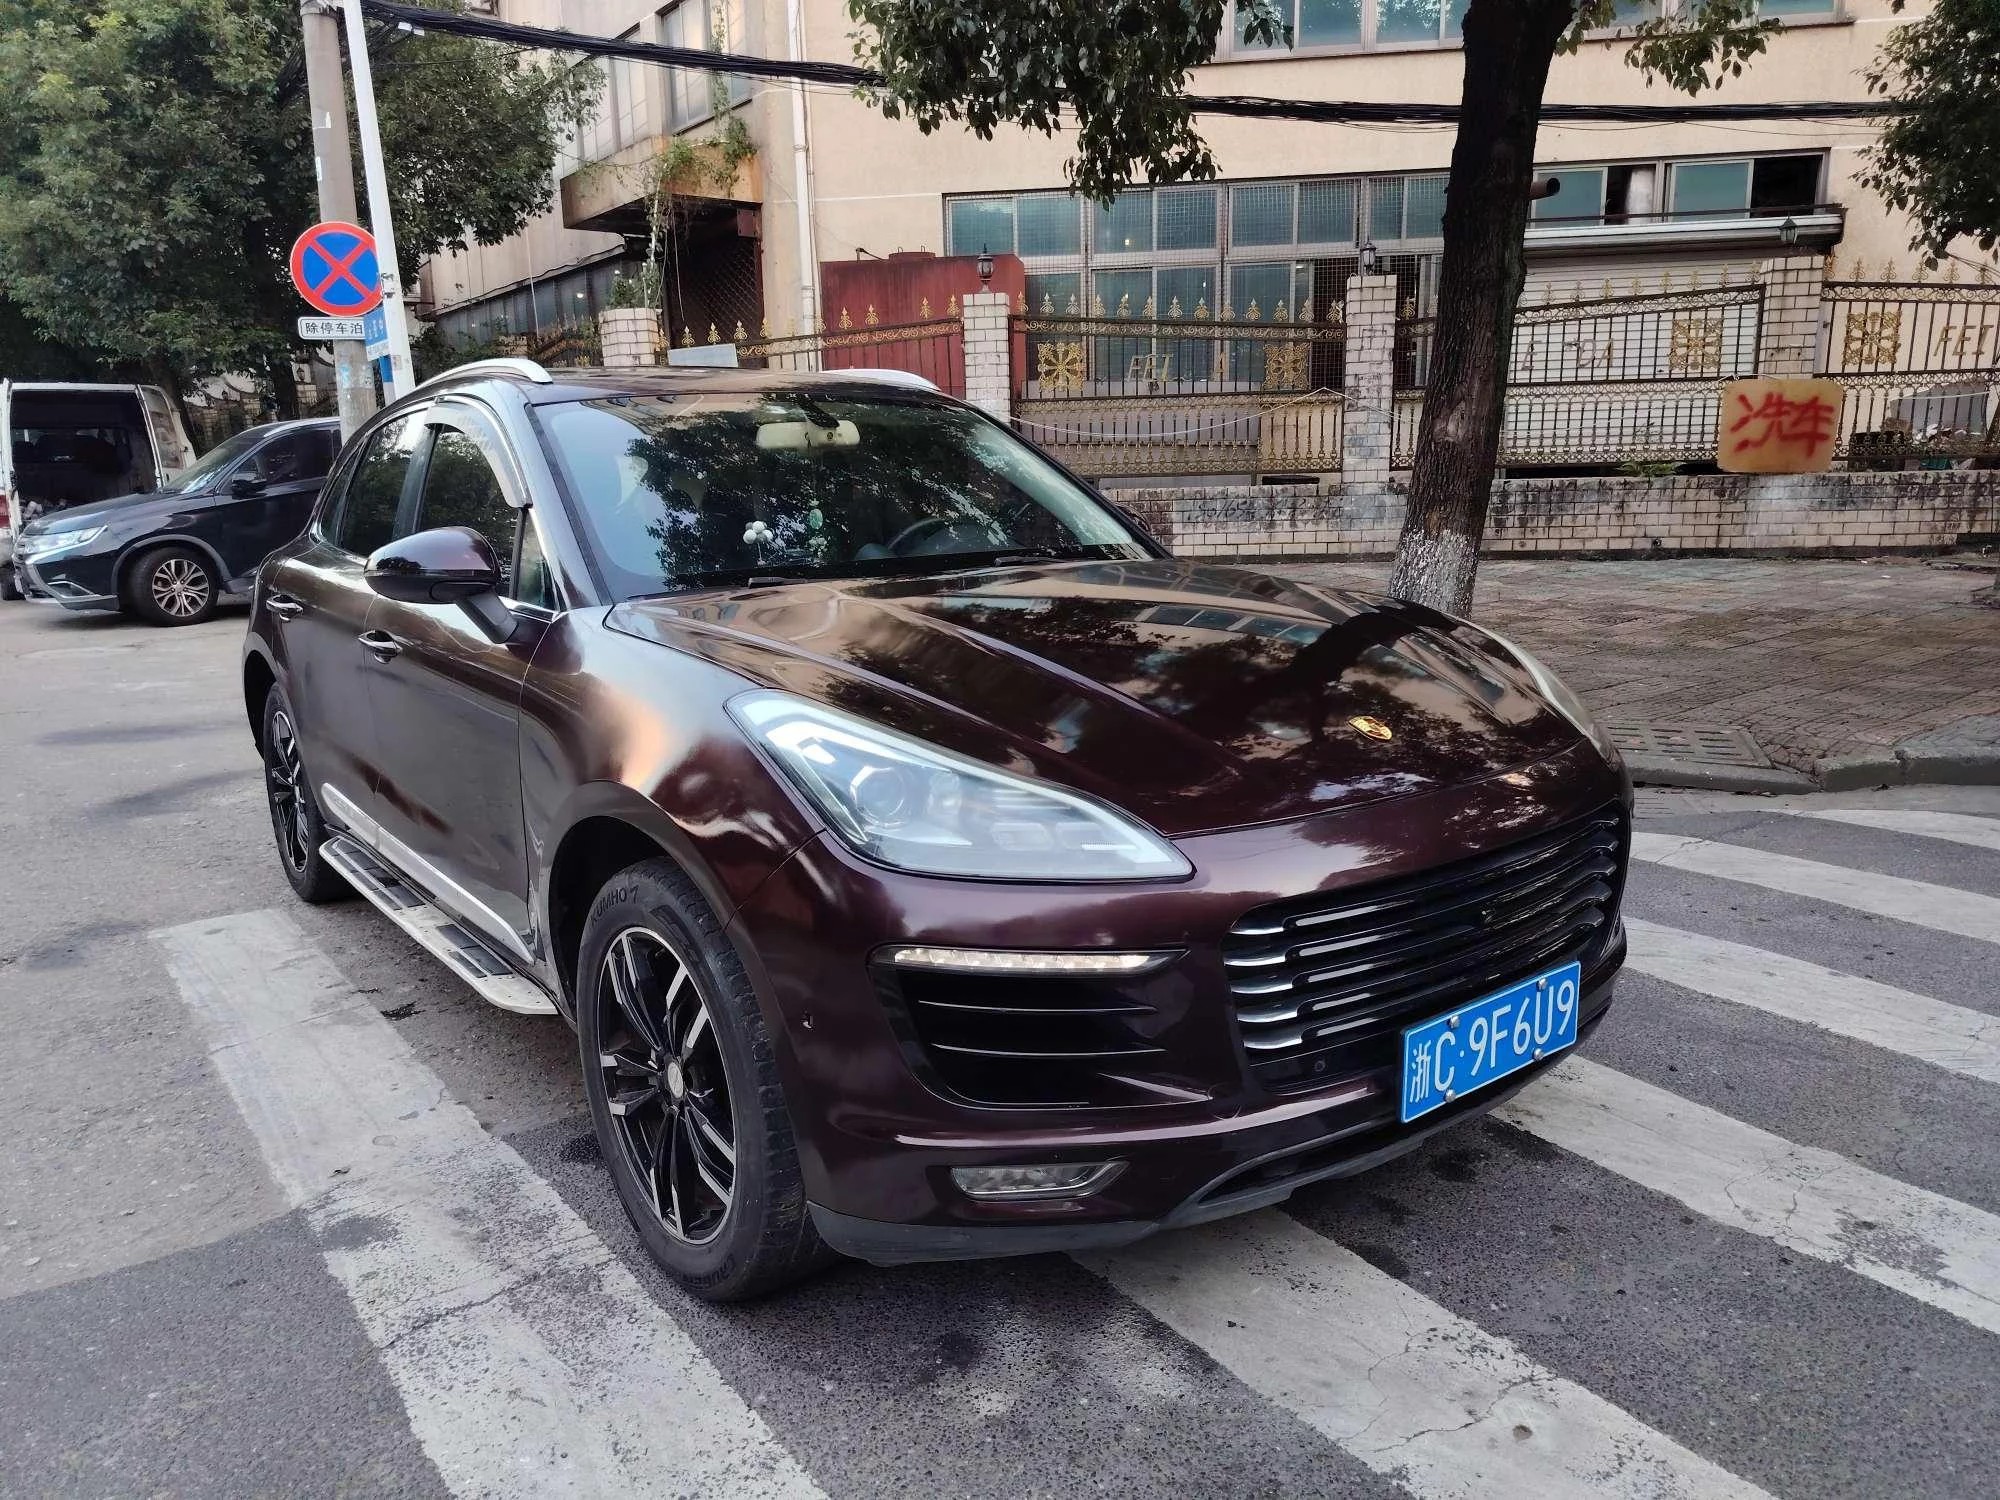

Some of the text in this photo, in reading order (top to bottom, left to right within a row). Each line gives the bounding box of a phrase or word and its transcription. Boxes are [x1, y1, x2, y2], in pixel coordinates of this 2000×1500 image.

[305, 321, 364, 335] 除停车泊
[1932, 324, 1995, 357] FEI
[1729, 391, 1835, 458] 洗车
